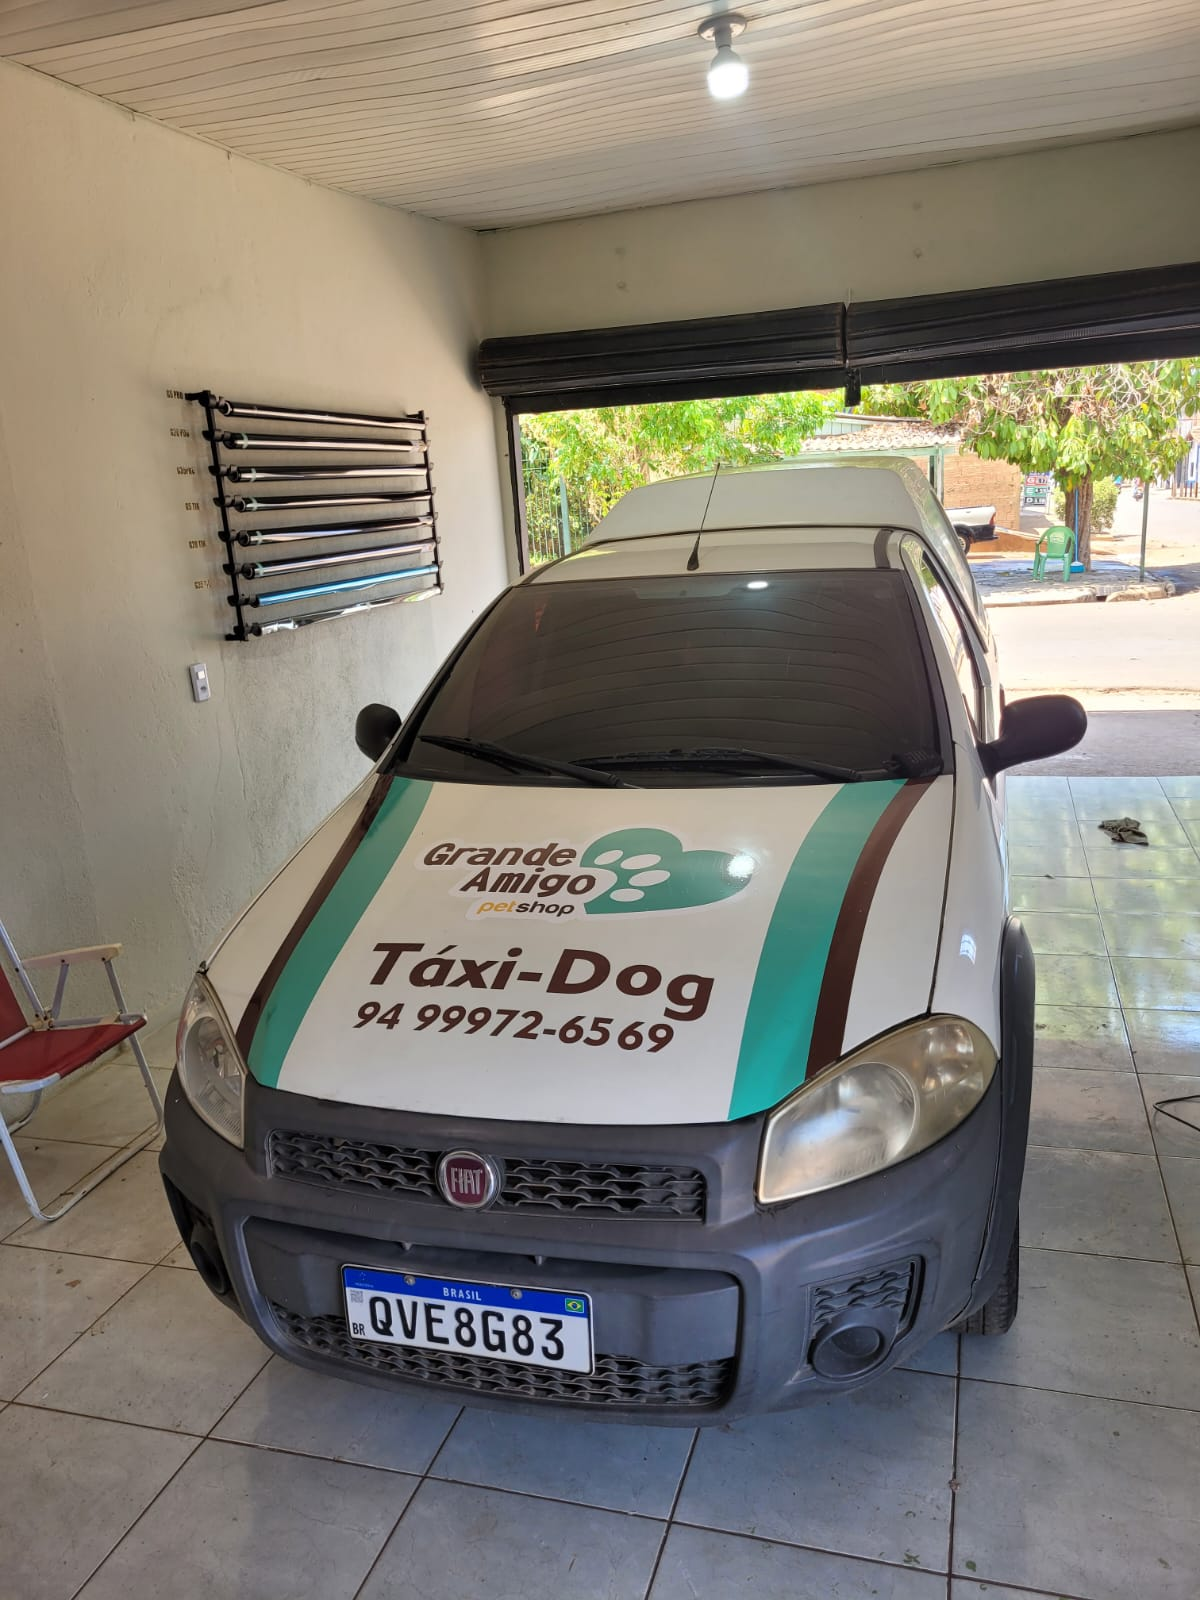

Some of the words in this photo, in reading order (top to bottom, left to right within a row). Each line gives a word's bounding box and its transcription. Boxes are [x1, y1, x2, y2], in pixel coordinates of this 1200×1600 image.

[423, 842, 577, 868] Grande
[459, 866, 597, 898] Amigo
[369, 942, 716, 1022] Táxi-Dog
[352, 1000, 405, 1030] 94
[412, 1004, 675, 1053] 99972-6569
[450, 1167, 482, 1195] FIAT
[442, 1287, 482, 1301] BRASIL
[352, 1322, 366, 1336] BR
[368, 1296, 565, 1361] QVE8G83
